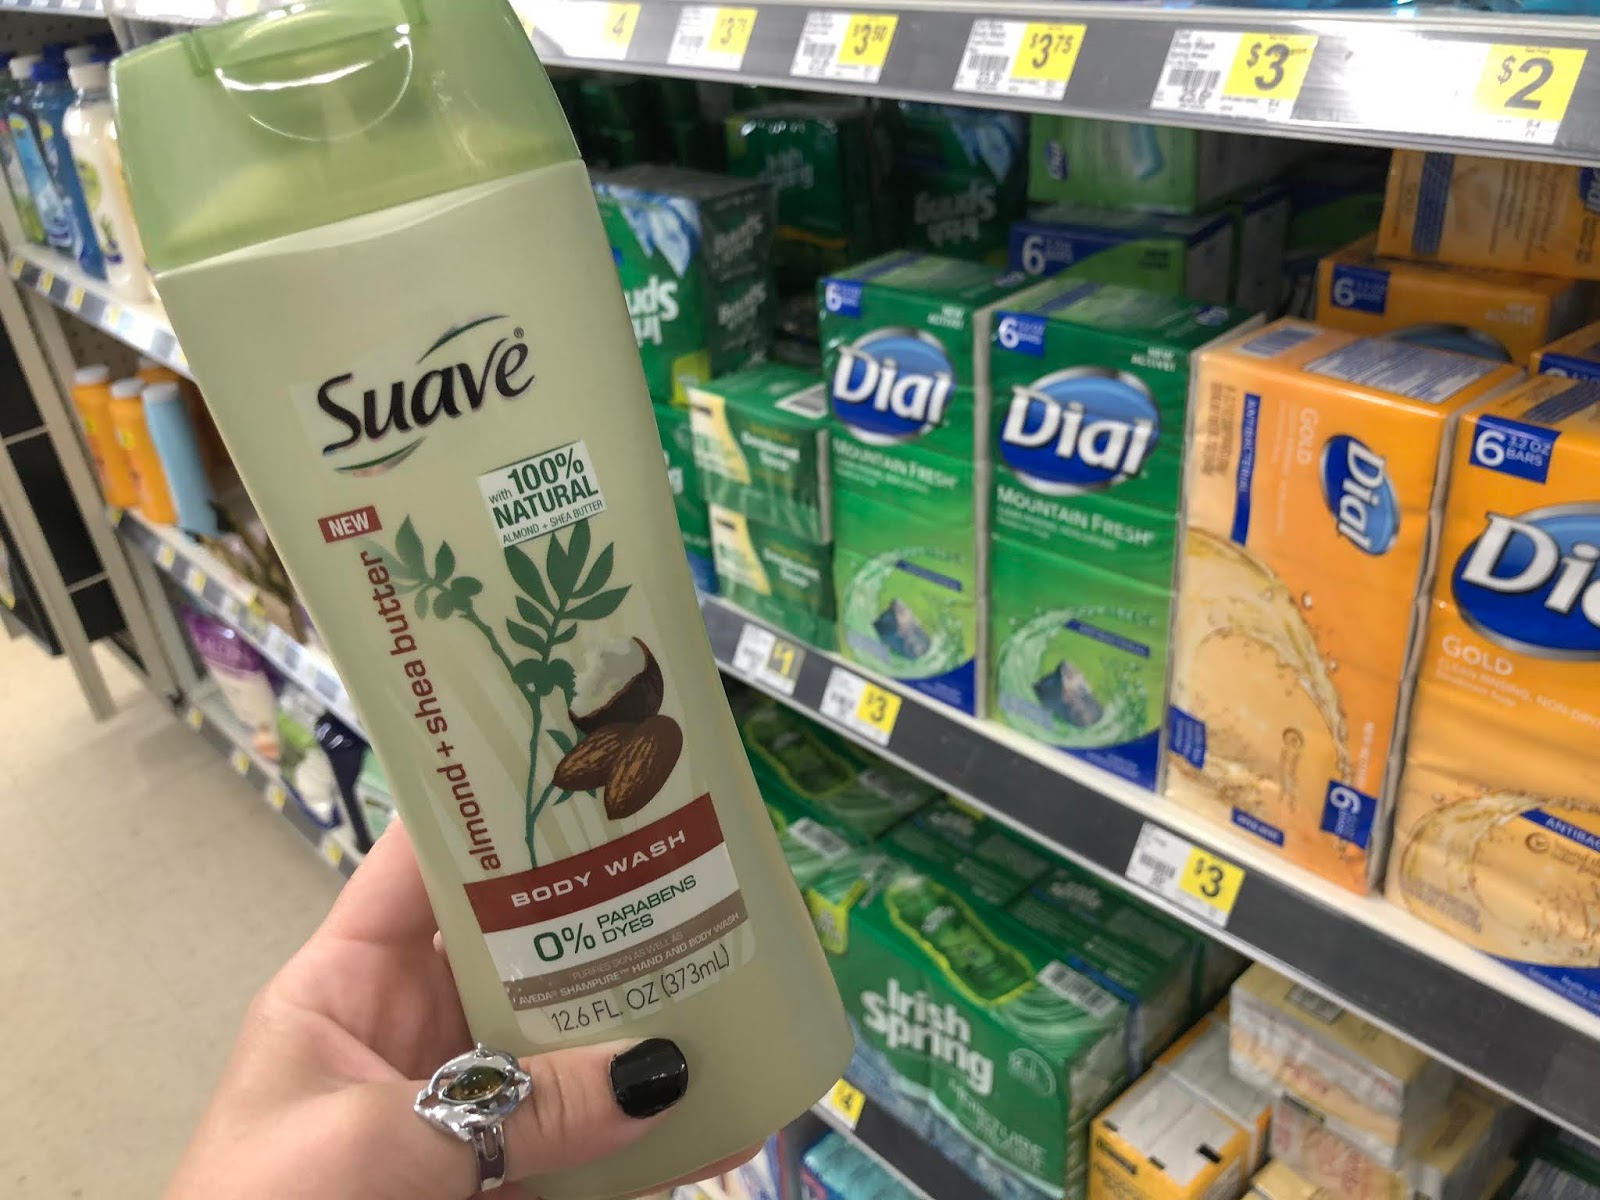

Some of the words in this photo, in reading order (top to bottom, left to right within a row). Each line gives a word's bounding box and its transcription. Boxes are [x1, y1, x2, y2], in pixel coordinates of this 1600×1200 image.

[1022, 235, 1046, 275] 6
[998, 317, 1019, 349] 6
[833, 346, 952, 425] Dial
[1002, 385, 1154, 475] Dial
[1474, 428, 1506, 467] 6
[489, 487, 513, 505] with
[508, 447, 585, 495] 100%
[492, 475, 599, 530] NATURAL
[1338, 441, 1386, 549] Dial
[327, 512, 370, 539] NEW
[502, 523, 540, 545] ALMOND
[549, 512, 573, 528] SHEA
[572, 499, 604, 519] BUTTER
[360, 550, 418, 657] butter
[1441, 634, 1514, 677] GOLD
[403, 659, 449, 735] shea
[437, 741, 454, 755] +
[436, 762, 502, 871] almond
[1329, 786, 1362, 815] 6
[511, 871, 593, 908] BODY
[604, 830, 687, 877] WASH
[533, 922, 596, 963] 0%
[596, 874, 697, 930] PARABENS
[601, 913, 655, 944] DYES
[631, 955, 664, 974] HAND
[664, 944, 688, 959] AND
[688, 929, 713, 948] BODY
[712, 912, 740, 931] WASH
[572, 963, 612, 981] PURIFIES
[611, 956, 632, 969] SKIN
[631, 950, 645, 962] AS
[643, 939, 670, 958] WELL
[670, 931, 684, 943] AS
[551, 1004, 591, 1033] 12.6
[592, 1000, 624, 1023] FL.
[626, 981, 660, 1011] OZ
[661, 943, 730, 999] (373mL)
[887, 977, 972, 1043] Irish
[859, 989, 995, 1097] Spring
